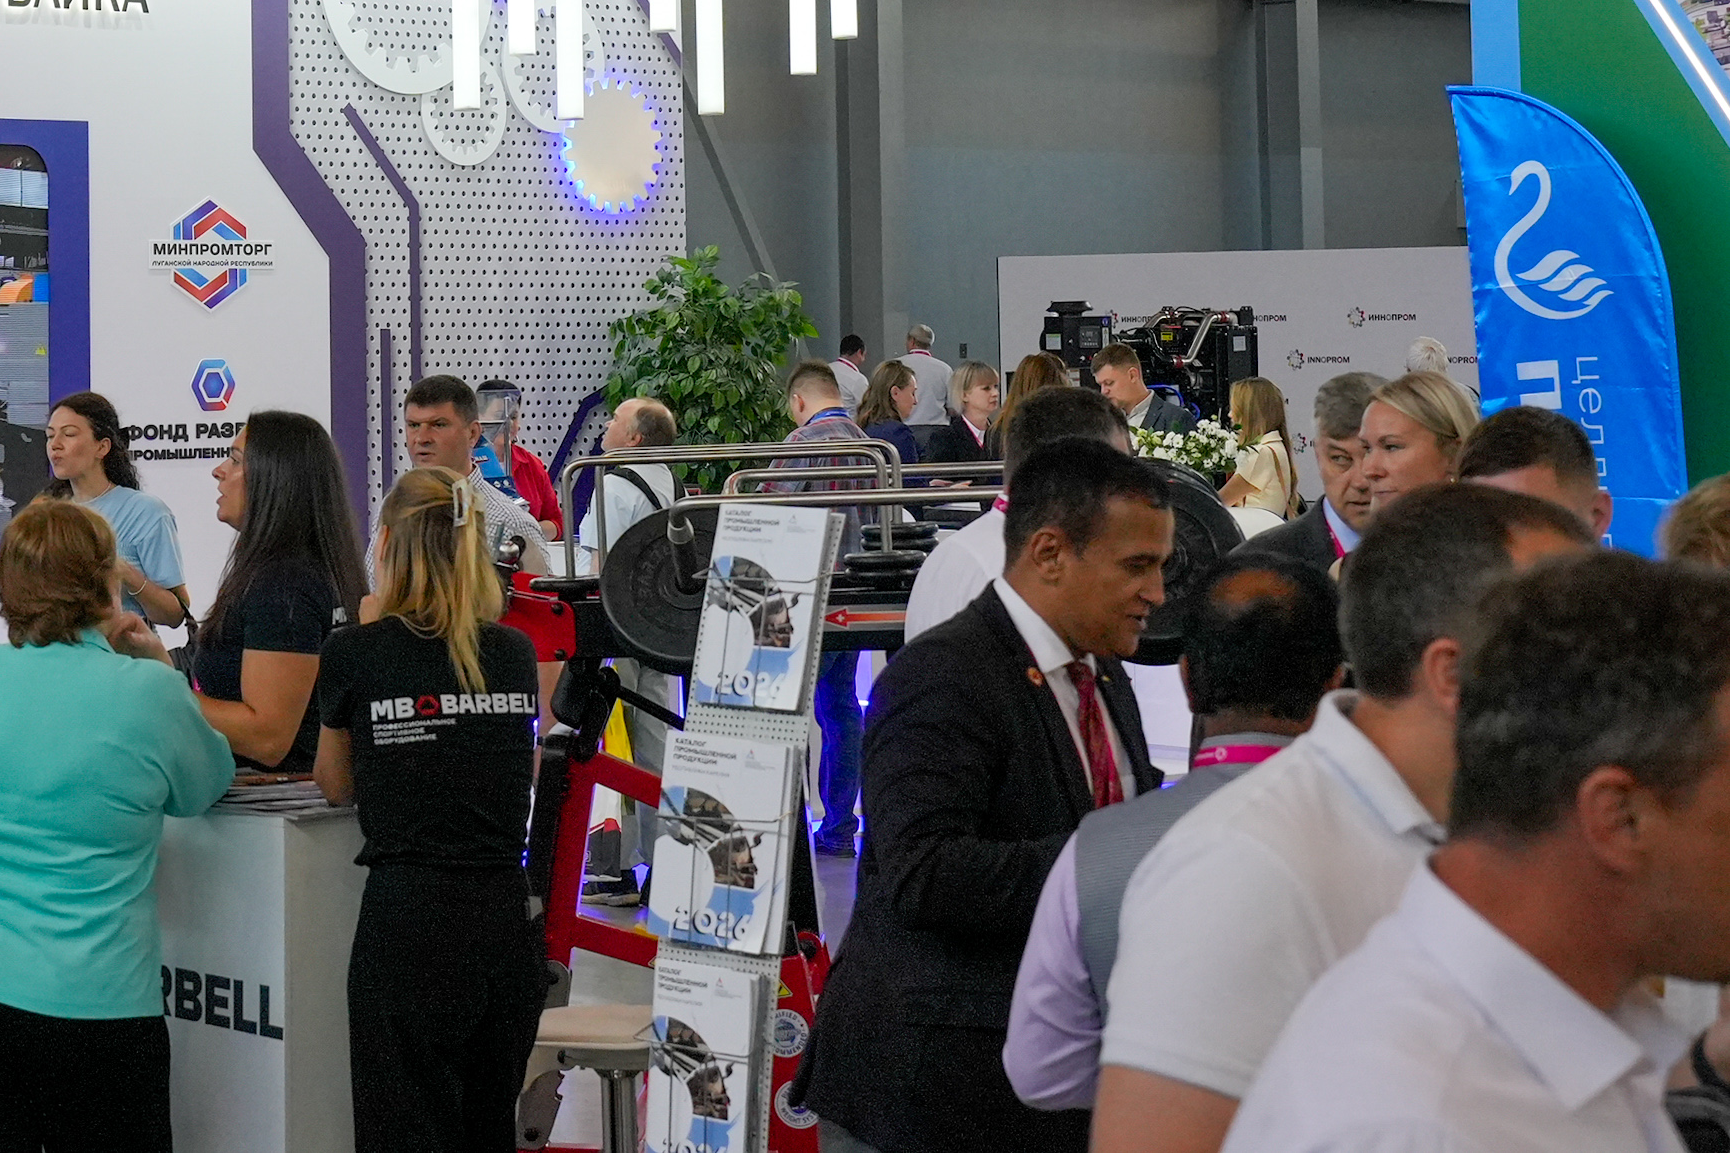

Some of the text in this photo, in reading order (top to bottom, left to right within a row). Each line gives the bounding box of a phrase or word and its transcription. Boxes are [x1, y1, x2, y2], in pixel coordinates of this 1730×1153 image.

[153, 243, 272, 255] МИНПРОМТОРГ
[192, 259, 229, 267] НАРОДНОЙ
[1368, 313, 1417, 321] ИННОПРОМ
[1307, 356, 1350, 364] INNOPROM
[129, 424, 189, 442] ФОНД
[370, 696, 416, 722] MB
[372, 717, 456, 731] ПРОФЕССИОНАЛЬНОЕ
[373, 727, 425, 738] СПОРТИВНОЕ
[374, 733, 437, 746] ОБОРУДОВАНИЕ
[675, 737, 707, 747] КАТАЛОГ
[673, 745, 737, 760] ПРОМЫШЛЕННОЙ
[673, 753, 717, 765] ПРОДУКЦИИ
[673, 905, 751, 941] 2026
